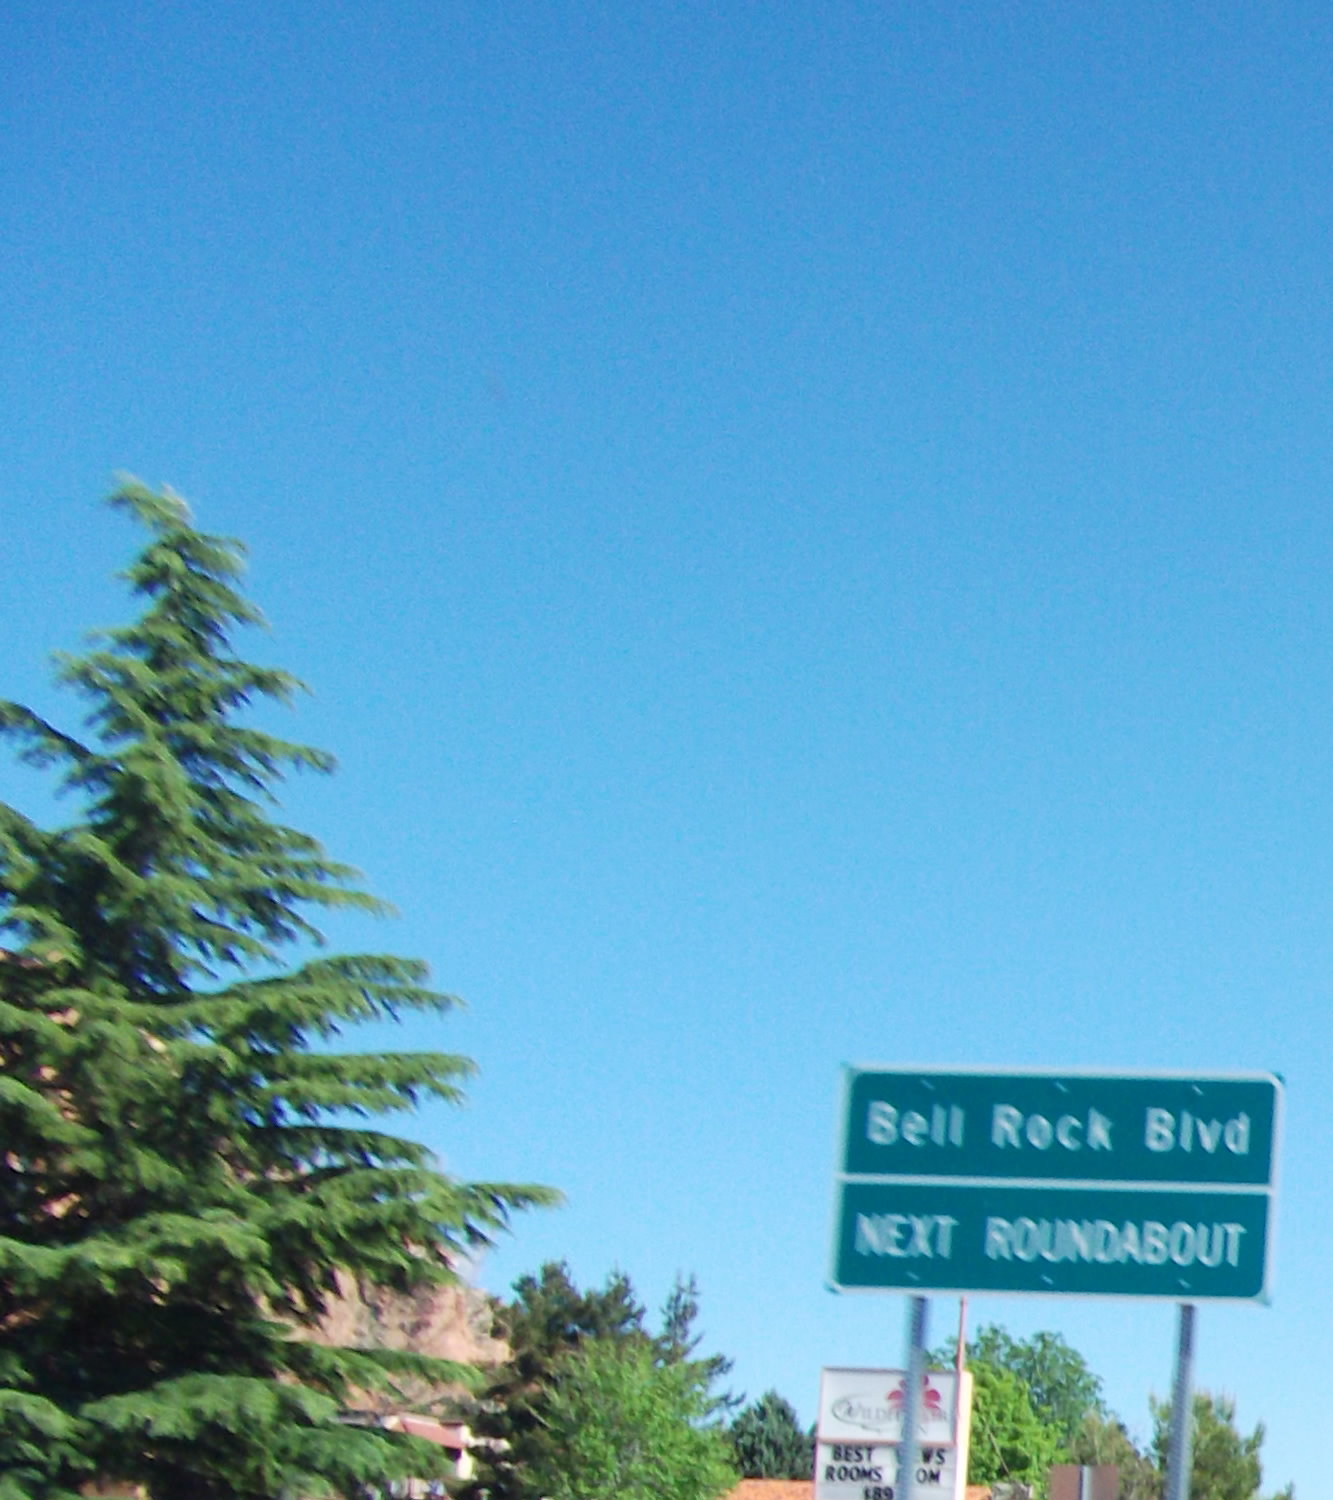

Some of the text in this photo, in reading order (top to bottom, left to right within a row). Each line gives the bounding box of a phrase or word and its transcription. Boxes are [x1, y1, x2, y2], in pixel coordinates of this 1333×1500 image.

[866, 1100, 1252, 1156] Bell Rock Blvd
[855, 1212, 1247, 1268] NEXT ROUNDABOUT
[833, 1446, 875, 1463] BEST
[825, 1466, 883, 1483] ROOMS
